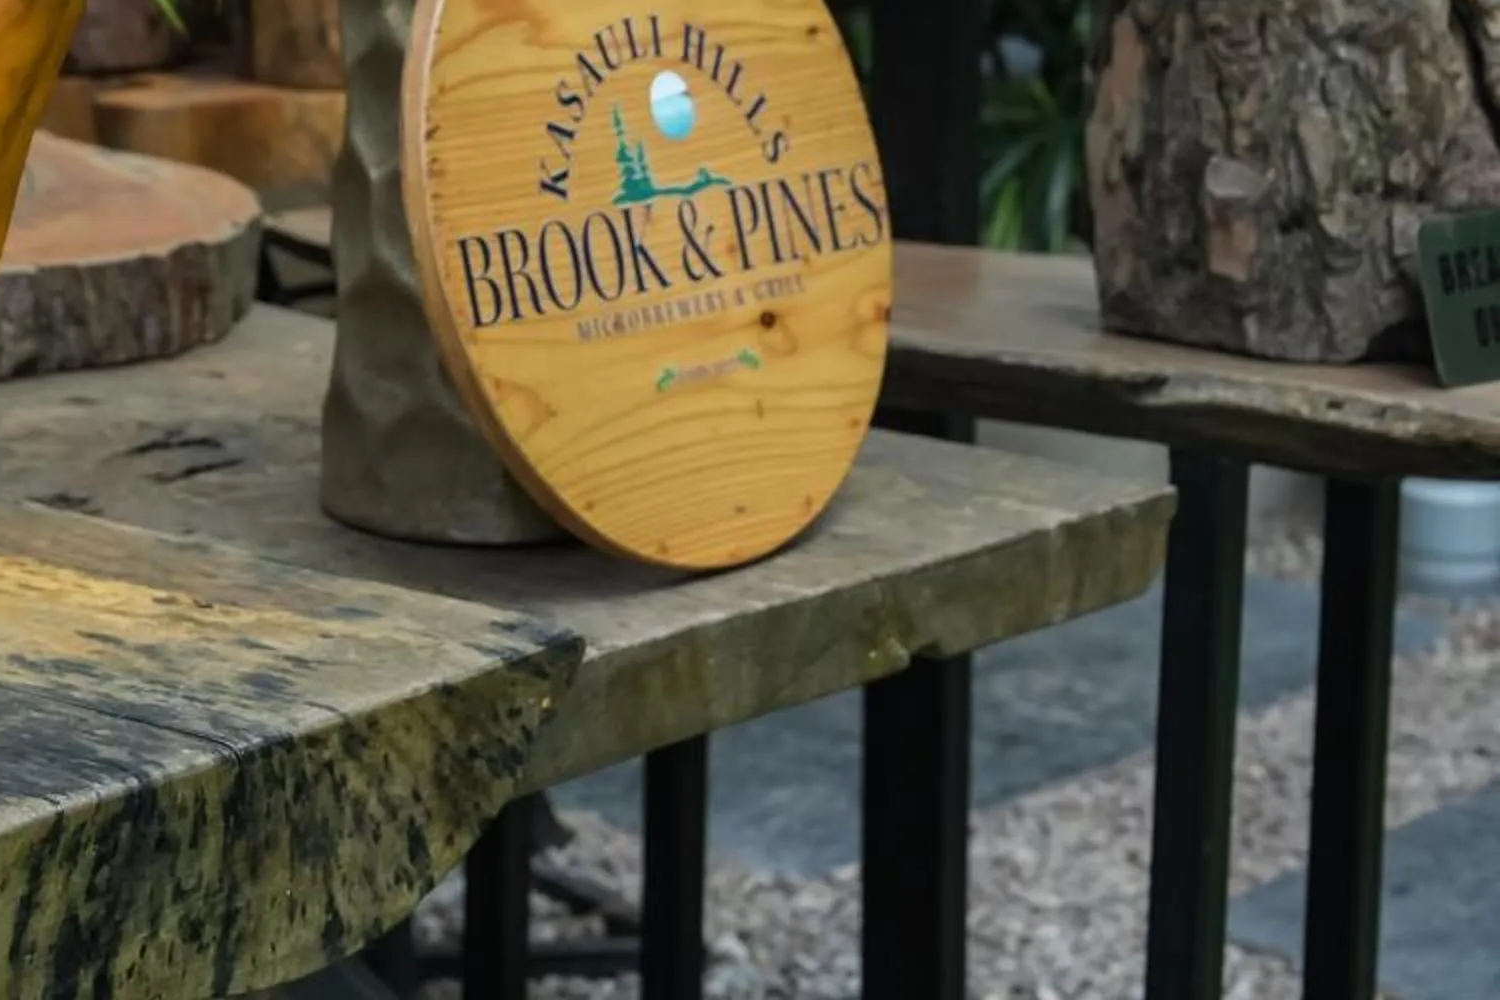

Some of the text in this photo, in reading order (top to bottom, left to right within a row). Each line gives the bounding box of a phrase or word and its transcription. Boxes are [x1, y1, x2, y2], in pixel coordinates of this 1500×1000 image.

[538, 14, 791, 200] KASAULI HILLS
[456, 161, 885, 329] BROOK & PINES
